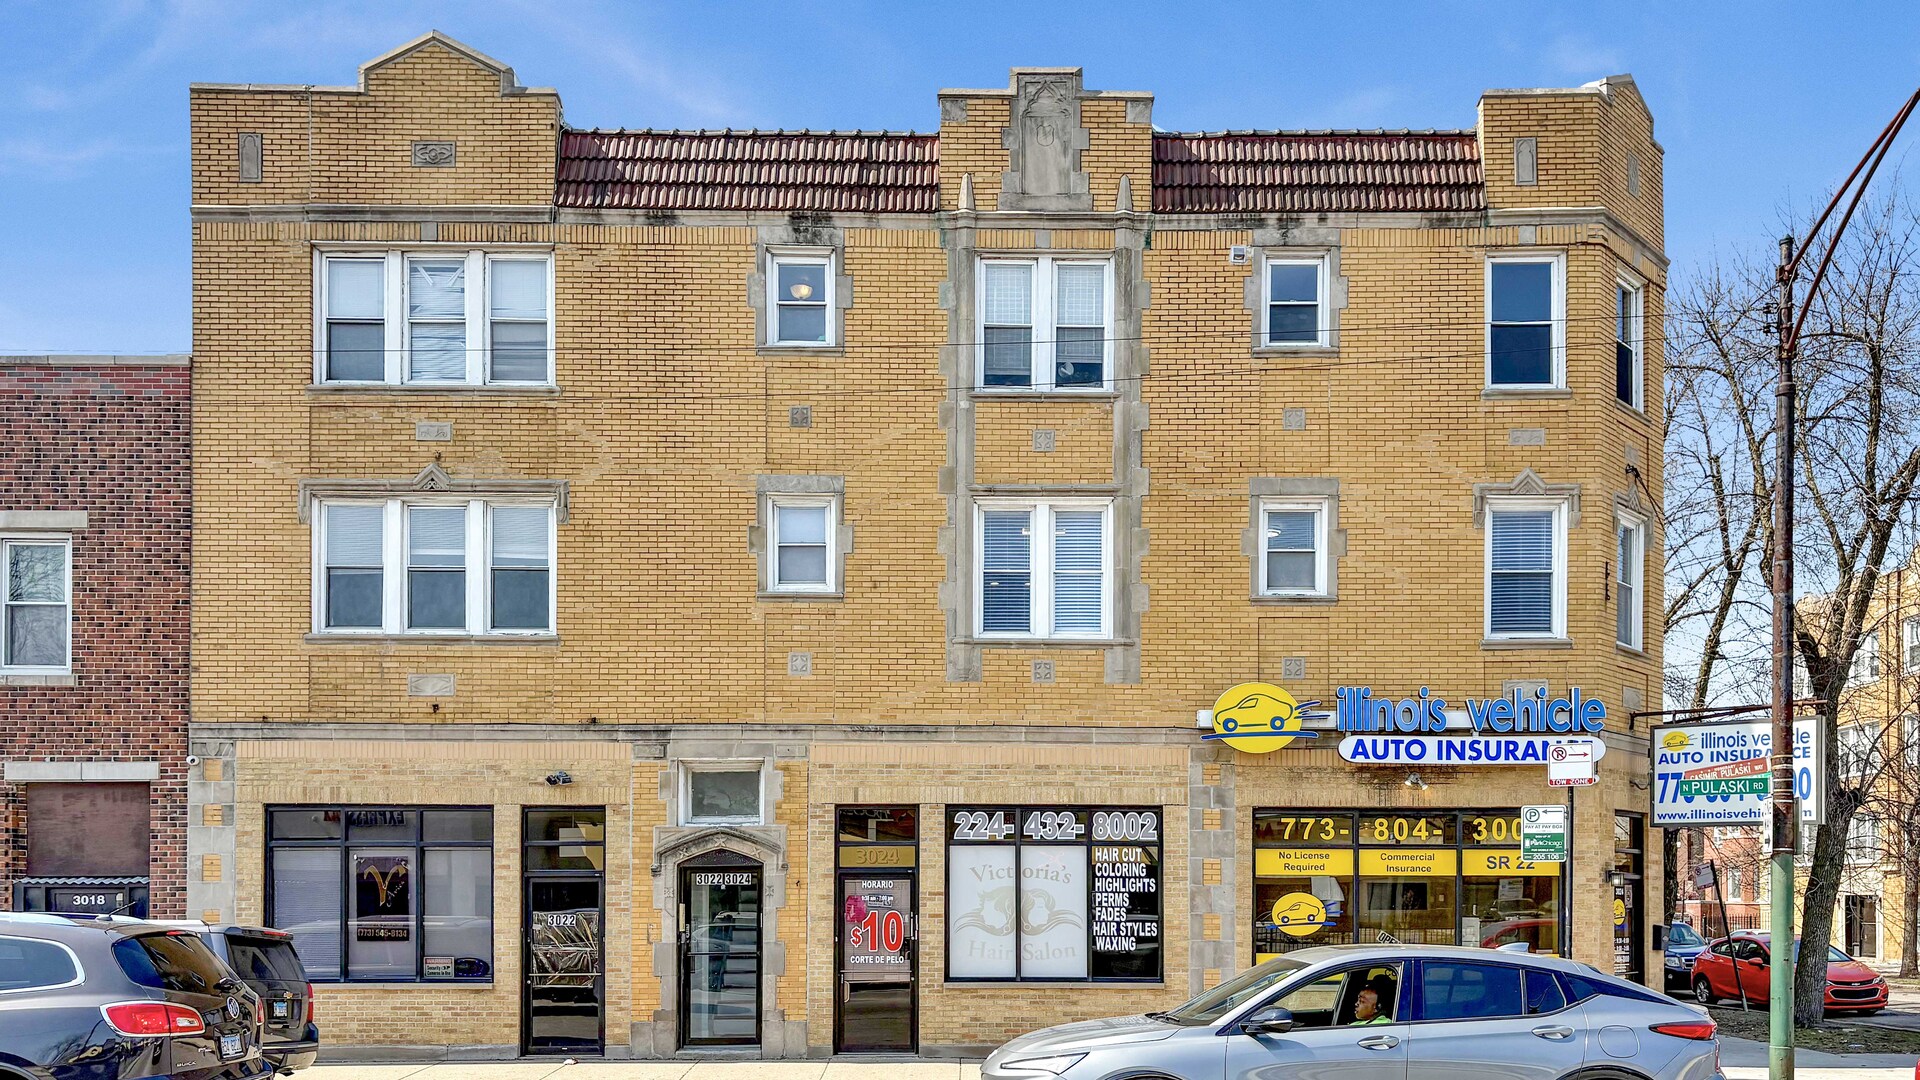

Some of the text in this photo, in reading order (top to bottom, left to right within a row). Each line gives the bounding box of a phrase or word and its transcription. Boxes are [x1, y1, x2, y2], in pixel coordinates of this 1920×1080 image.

[1337, 686, 1607, 732] illinois vehicle
[1701, 727, 1811, 749] illinois vele
[1351, 739, 1593, 761] AUTO INSURA
[1658, 747, 1811, 765] AUTO INSURCE
[1721, 764, 1751, 777] PULASKI
[1553, 777, 1588, 786] TOW ZONE
[1683, 780, 1764, 794] N PULASKI RD
[1657, 807, 1812, 820] www.illinoisvehim
[953, 811, 1158, 840] 224- 432- 8002
[1280, 817, 1350, 841] 773-
[1374, 817, 1443, 841] 804-
[1472, 817, 1522, 841] 300
[856, 848, 900, 865] 3024
[1095, 847, 1142, 862] HAIR CUT
[1279, 851, 1330, 860] No License
[1380, 852, 1435, 861] Commercial
[1095, 862, 1147, 877] COLORING
[1284, 862, 1325, 873] Required
[1386, 864, 1432, 873] Insurance
[1486, 855, 1510, 870] SR
[697, 873, 751, 885] 3022 3024
[969, 863, 1072, 885] Victoria's
[861, 880, 894, 889] HORARIO
[1095, 877, 1156, 892] HIGHLIGHTS
[72, 895, 106, 905] 3018
[1095, 892, 1130, 907] PERMS
[548, 915, 576, 926] 3022
[1095, 907, 1127, 921] FADES
[850, 910, 904, 953] $10
[1093, 921, 1158, 937] HAIR STYLES
[1096, 936, 1137, 951] WAXING
[1378, 932, 1398, 944] OPE
[968, 940, 1076, 961] Hair Salon
[850, 955, 905, 964] CORTE DE PELO
